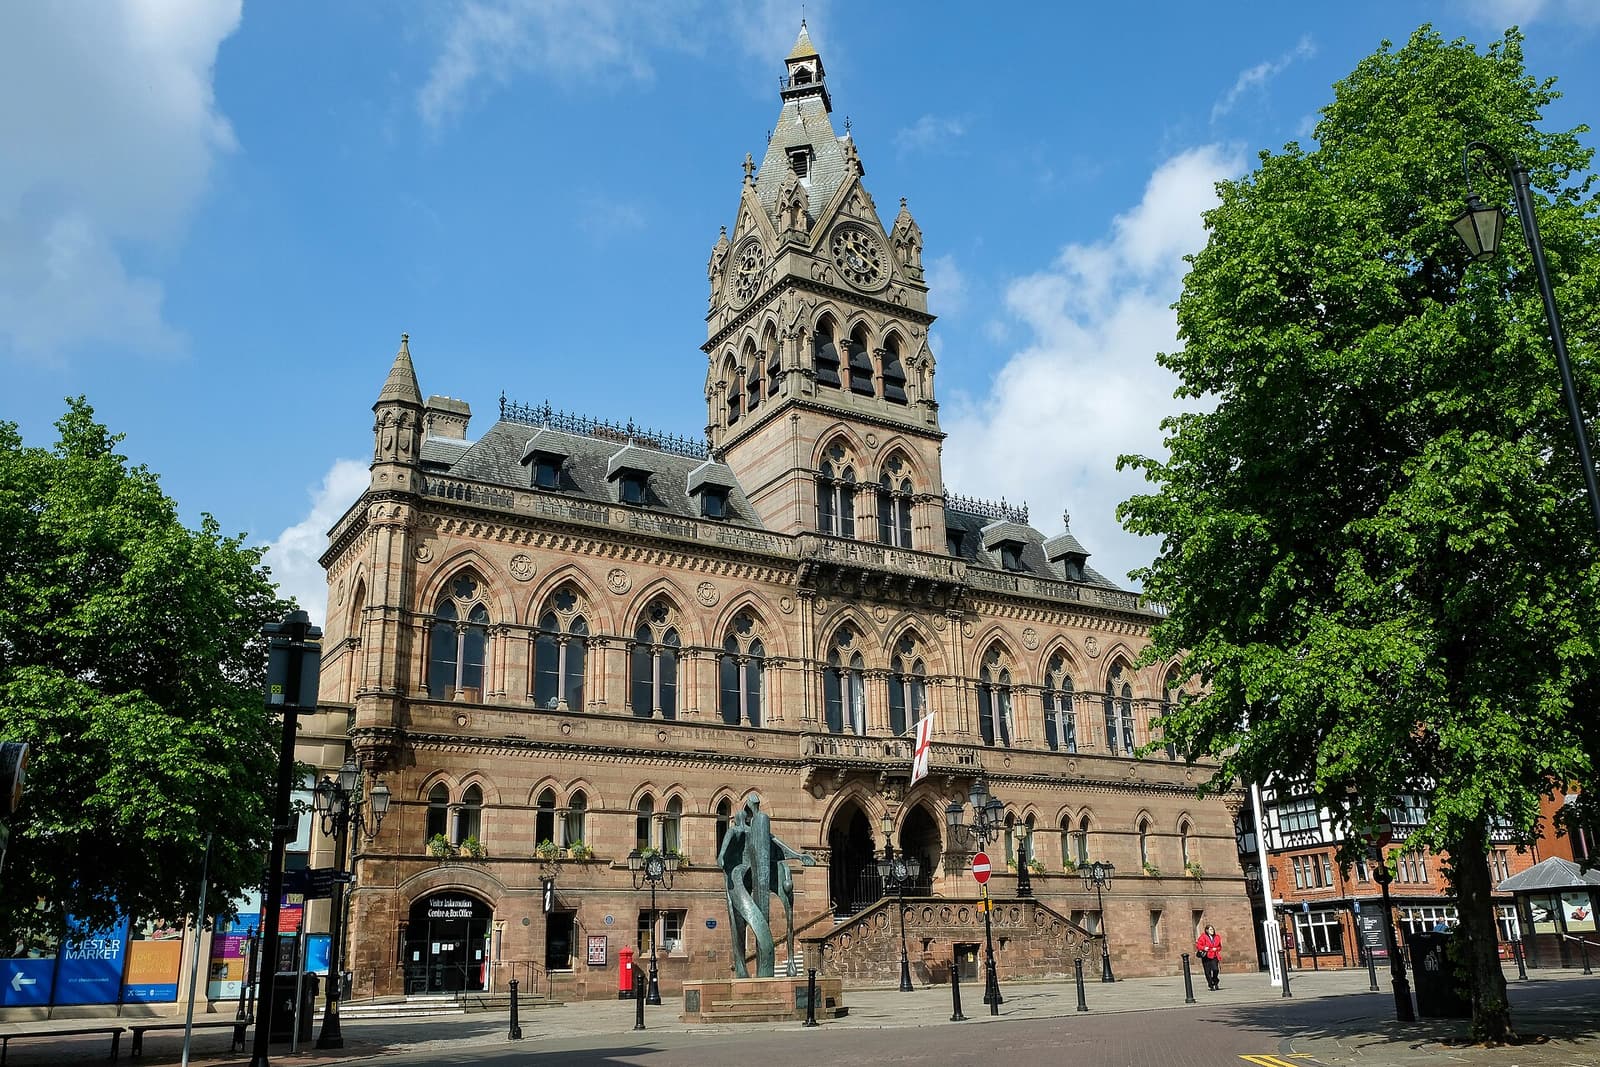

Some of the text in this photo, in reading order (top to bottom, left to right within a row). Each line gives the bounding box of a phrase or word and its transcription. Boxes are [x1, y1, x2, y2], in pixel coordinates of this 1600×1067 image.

[429, 898, 472, 907] Visitor Information
[428, 909, 444, 917] Centre
[450, 909, 458, 917] Box
[458, 909, 472, 917] Office
[65, 949, 119, 960] MARKET
